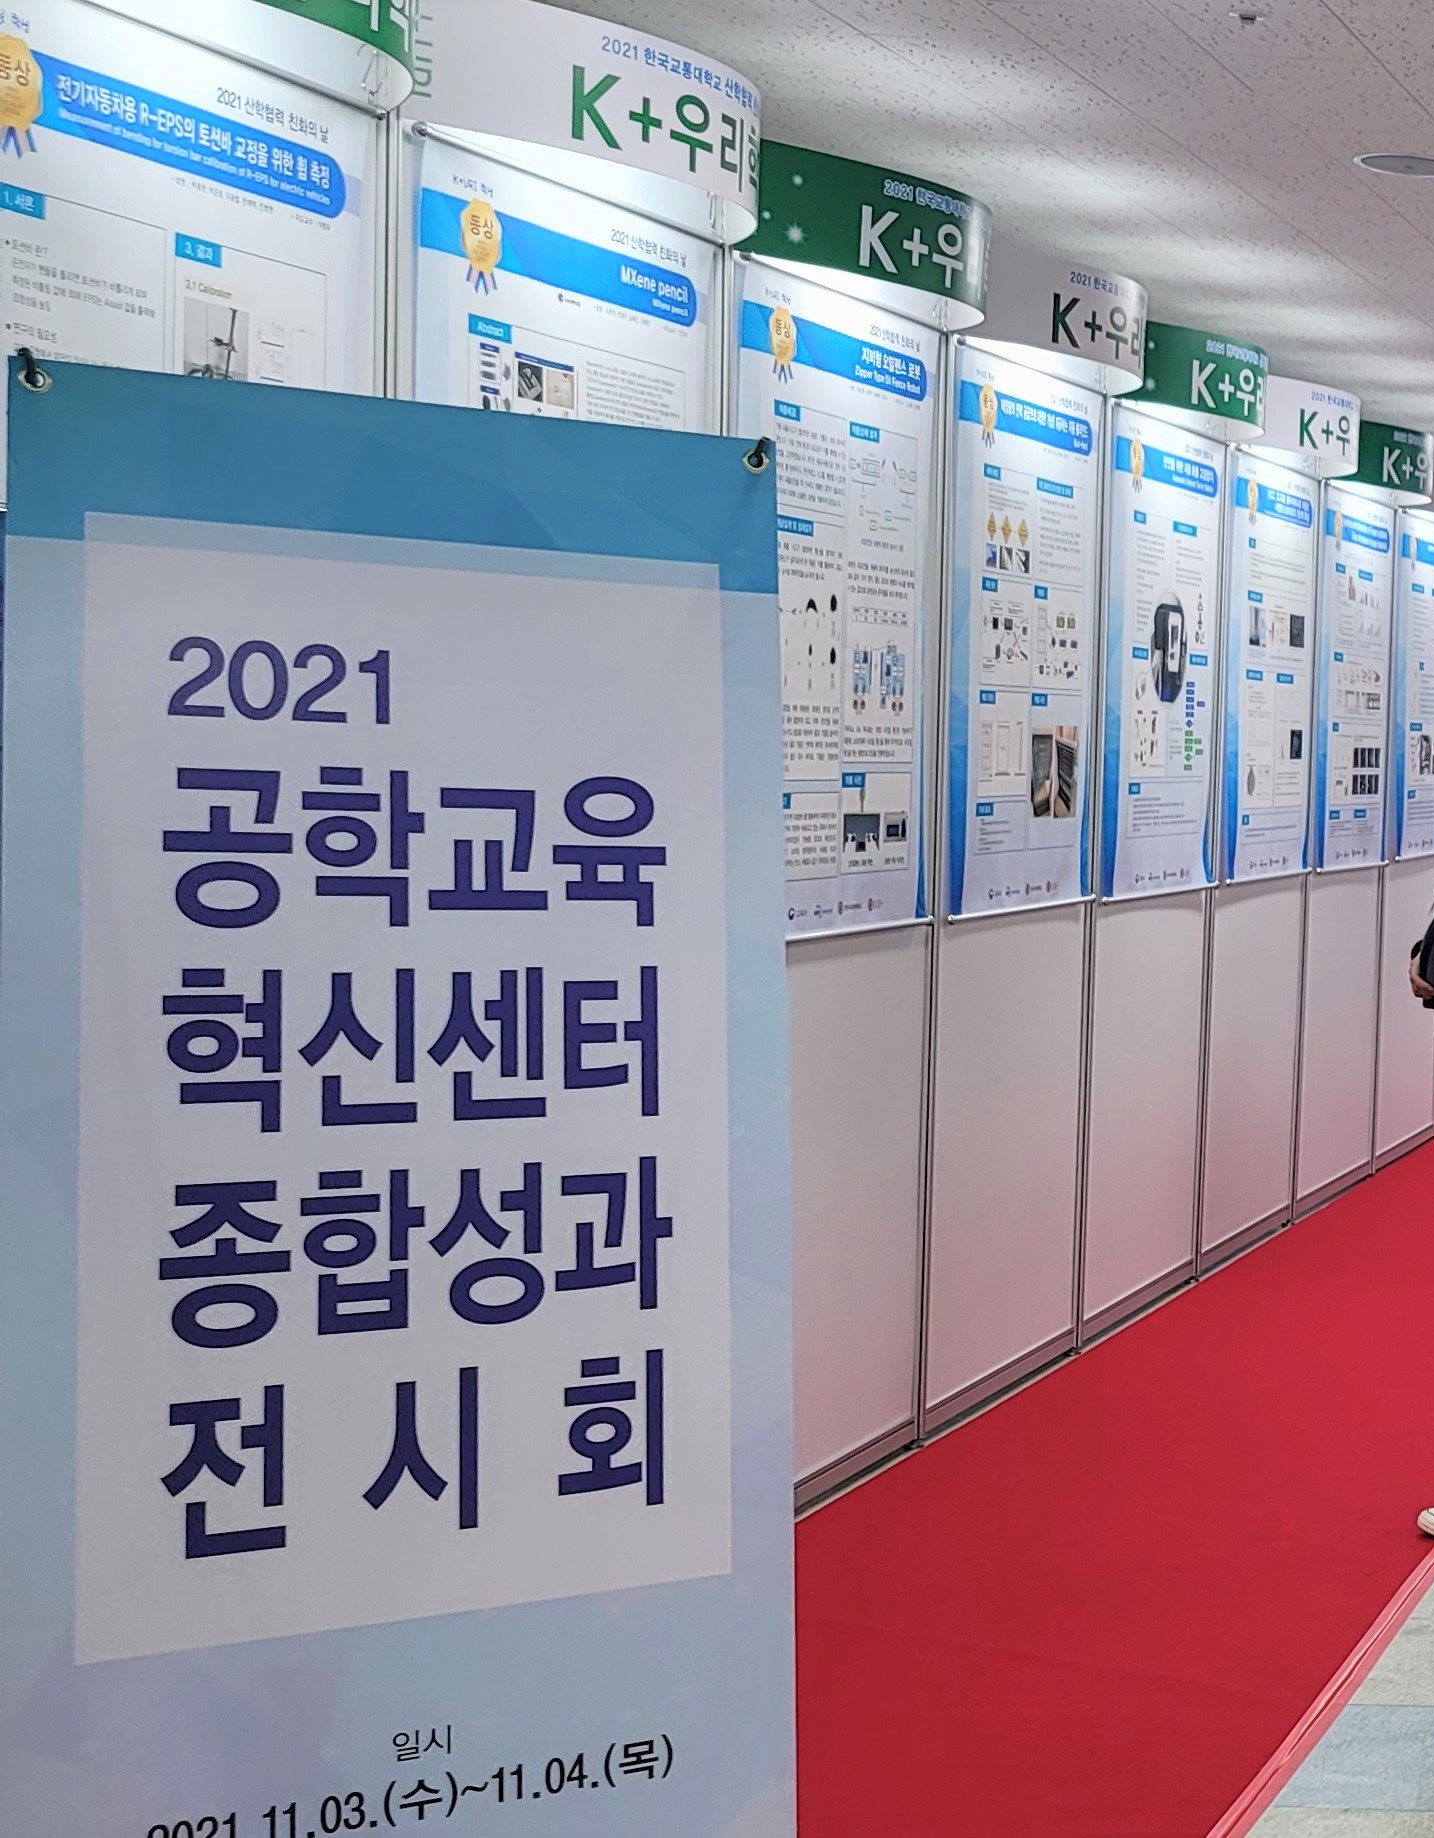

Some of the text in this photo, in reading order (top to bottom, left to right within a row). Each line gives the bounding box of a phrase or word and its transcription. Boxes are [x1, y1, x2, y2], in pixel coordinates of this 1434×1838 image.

[602, 36, 638, 60] 2021
[644, 47, 722, 91] 한국교통대학교
[56, 74, 330, 189] 전기자동차용 R-EPS의 토션바 교정을 위한 힘 측정
[217, 87, 329, 144] 2021 산학협력 친화의 날
[883, 179, 914, 202] 2021
[470, 214, 494, 240] 동상
[611, 228, 629, 246] 2021
[620, 264, 689, 304] MXene pencil
[1070, 271, 1091, 287] 2021
[167, 636, 391, 725] 2021
[162, 765, 667, 929] 공학교육
[162, 965, 660, 1133] 혁신센터
[158, 1155, 674, 1349] 종합성과
[391, 1725, 452, 1763] 일시
